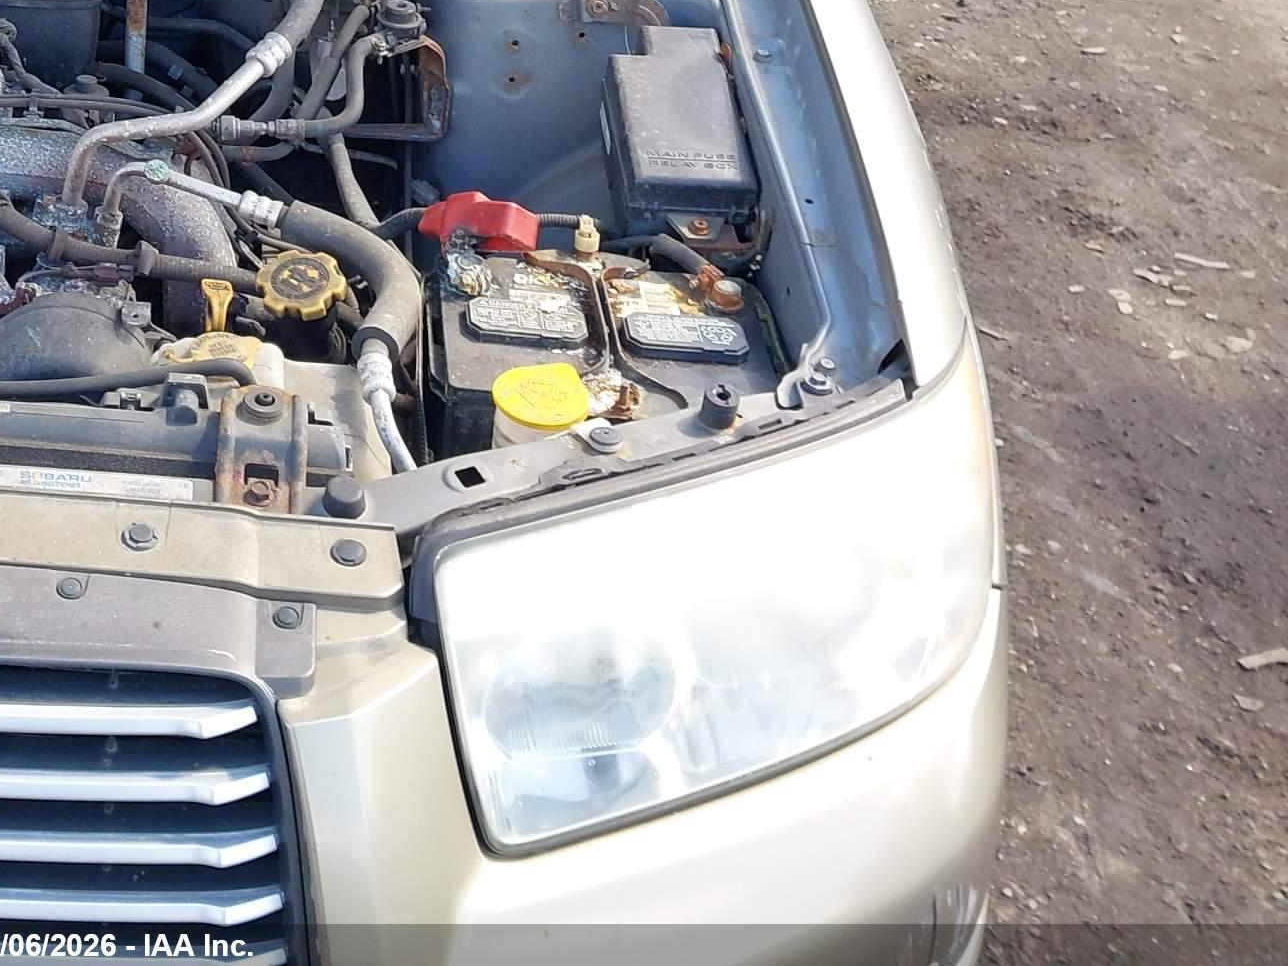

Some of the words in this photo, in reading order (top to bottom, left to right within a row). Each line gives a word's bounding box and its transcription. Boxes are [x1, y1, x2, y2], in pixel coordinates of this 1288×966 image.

[647, 149, 689, 159] MAIN
[693, 152, 736, 160] FUSE
[648, 160, 697, 169] RELAY
[703, 162, 739, 171] BOX
[19, 469, 93, 483] SUBARU
